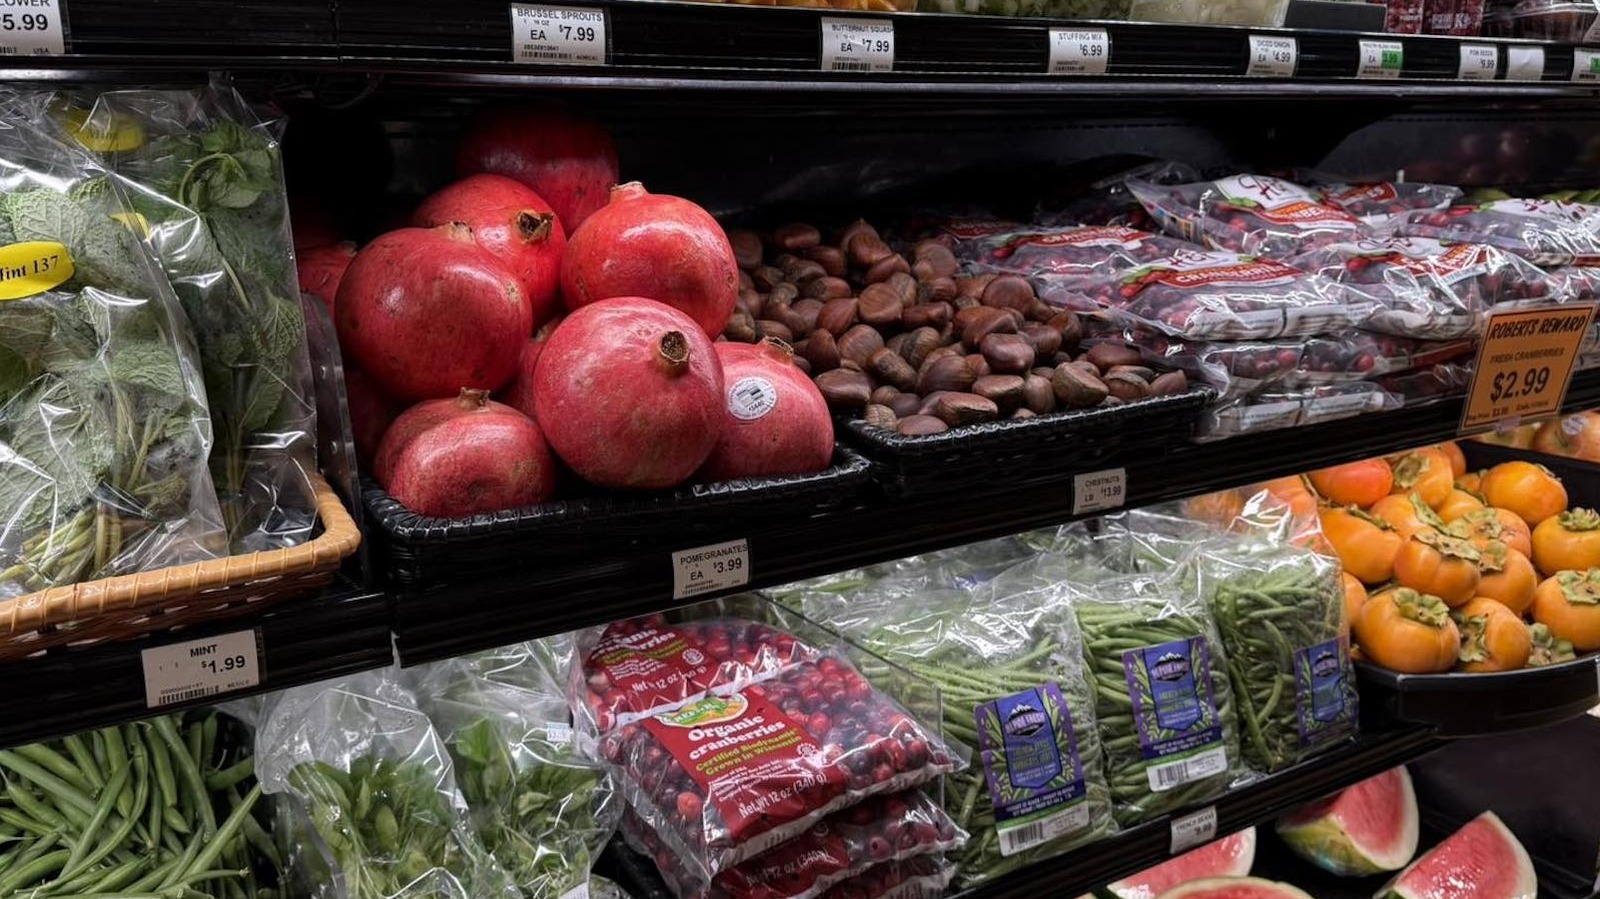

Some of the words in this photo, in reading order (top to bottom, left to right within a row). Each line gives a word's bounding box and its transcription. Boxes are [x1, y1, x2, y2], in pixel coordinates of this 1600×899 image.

[0, 13, 48, 31] 5.99
[517, 9, 559, 20] BRUSSEL
[560, 11, 603, 22] SPROUTS
[530, 29, 547, 41] EA
[559, 25, 595, 42] $7.99
[832, 24, 869, 33] BUTTERNUT
[841, 43, 853, 52] EA
[862, 39, 889, 53] $7.99
[1080, 43, 1102, 56] $6.99
[34, 255, 58, 274] 137
[1489, 318, 1539, 340] ROBERTS
[1538, 314, 1587, 335] REWARD
[1490, 366, 1550, 405] $2.99
[680, 543, 748, 566] POMEGRANATES
[690, 571, 704, 581] EA
[713, 557, 742, 574] $3.99
[190, 644, 218, 658] MINT
[201, 655, 246, 674] $1.99
[688, 715, 765, 742] Organic
[689, 721, 786, 761] cranberries
[696, 747, 741, 772] Certified
[706, 757, 743, 777] Grown
[769, 790, 781, 805] 12
[780, 787, 793, 800] oz
